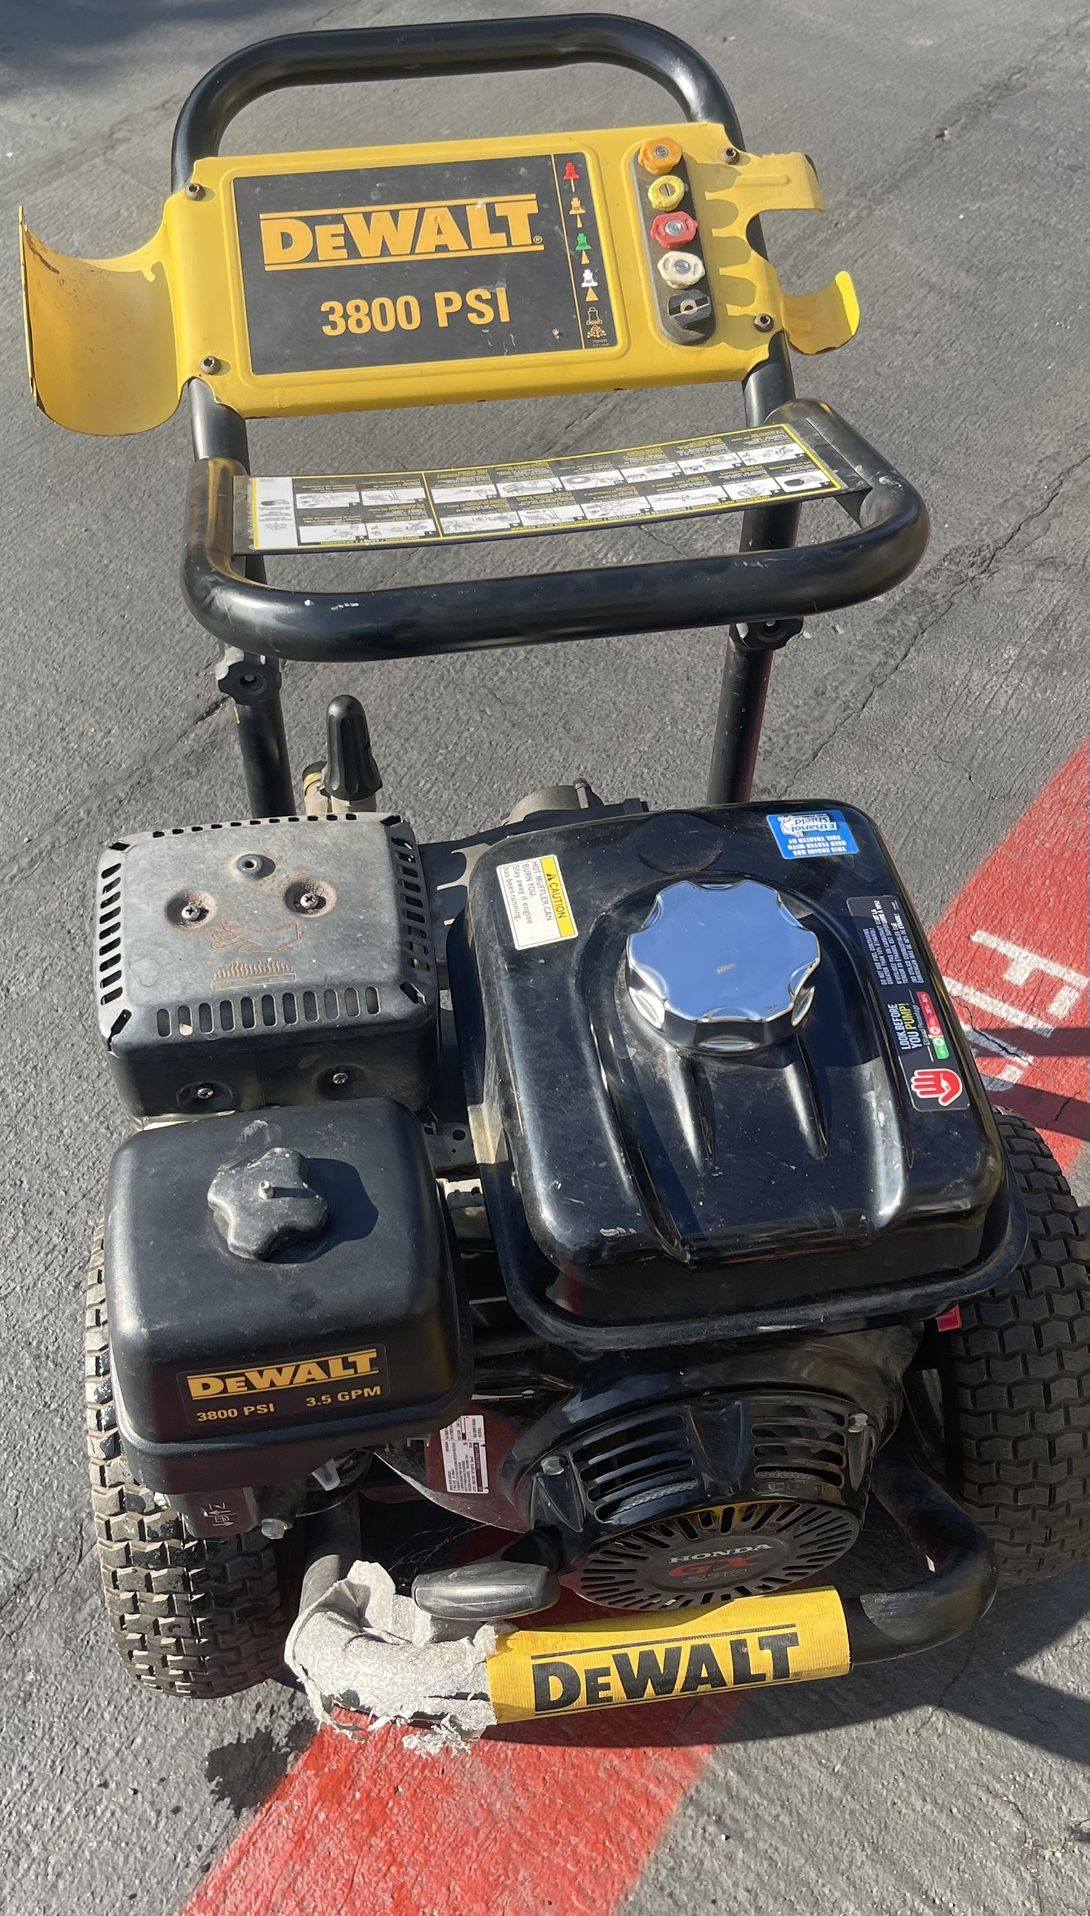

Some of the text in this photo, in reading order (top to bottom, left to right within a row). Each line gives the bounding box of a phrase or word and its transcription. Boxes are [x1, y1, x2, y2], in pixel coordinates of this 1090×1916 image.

[260, 200, 539, 265] DEWALT
[320, 287, 511, 337] 3800 PSI
[790, 824, 836, 833] Ethanol
[794, 817, 828, 825] Shield
[503, 867, 511, 878] has
[511, 865, 522, 878] Stay
[522, 864, 533, 882] BURN
[506, 879, 515, 894] been
[515, 879, 526, 896] away
[531, 861, 553, 921] HOT MUFFLER CAN
[549, 882, 567, 919] CAUTION
[521, 902, 533, 925] engine
[887, 1003, 912, 1050] LOOK BEFORE
[898, 1002, 923, 1048] YOU PUMP!
[187, 1352, 378, 1398] DEWALT
[197, 1386, 382, 1422] 3800 PSI 3.5 GPM
[668, 1552, 765, 1577] GX
[669, 1544, 773, 1563] HONDA
[531, 1632, 800, 1712] DEWALT
